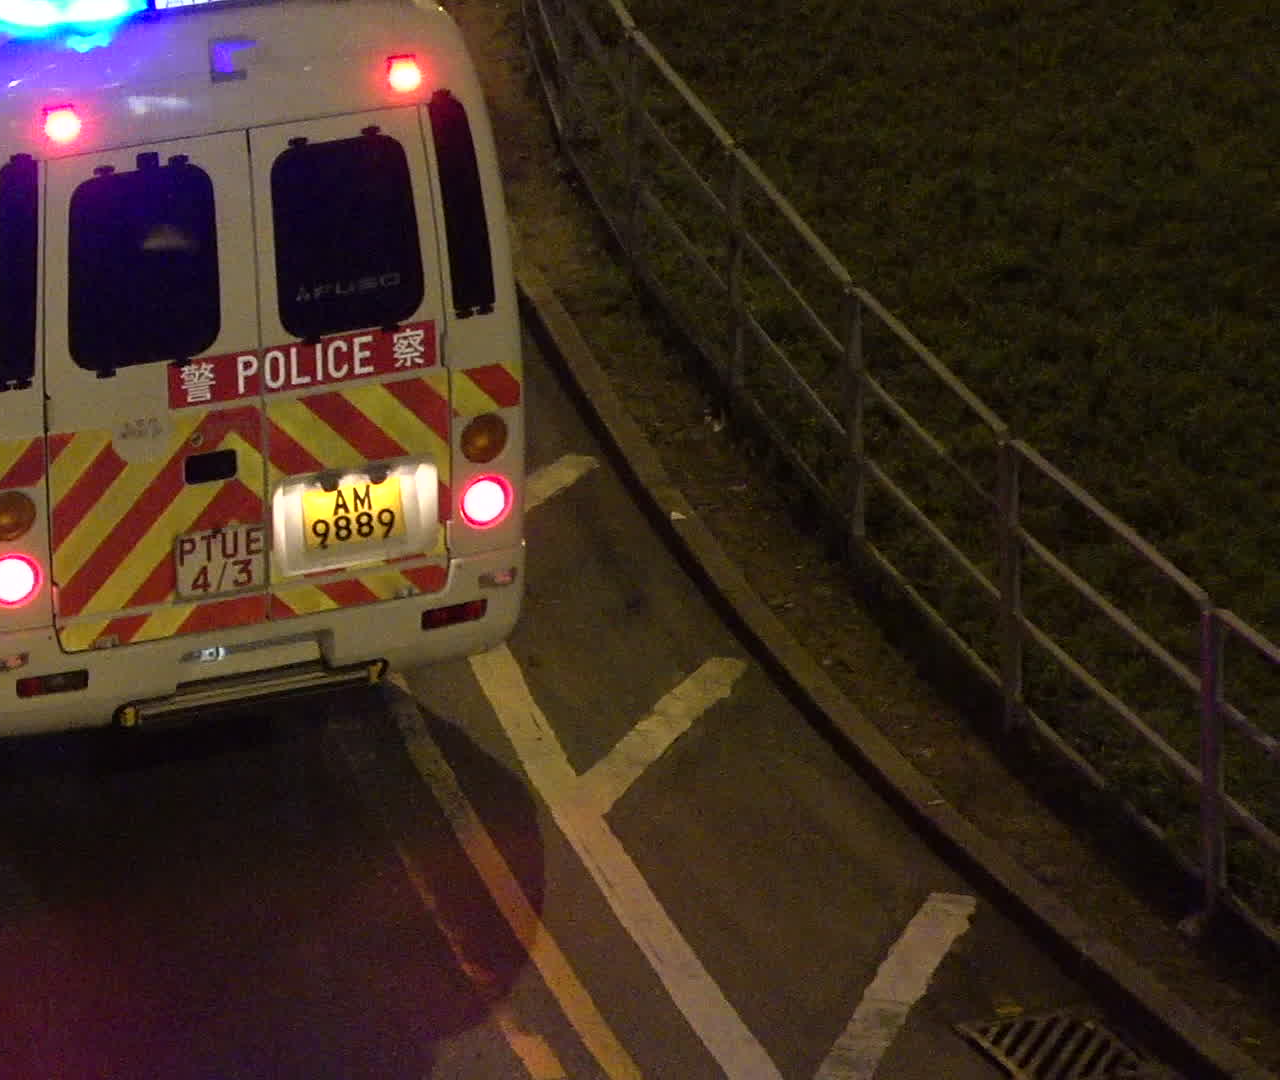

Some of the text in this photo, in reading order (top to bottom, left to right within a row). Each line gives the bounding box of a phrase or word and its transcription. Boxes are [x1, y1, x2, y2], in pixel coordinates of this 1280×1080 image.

[180, 327, 425, 404] 警 POLICE 察
[332, 484, 373, 517] AM
[179, 526, 264, 568] PTUE
[311, 508, 396, 550] 9889
[190, 558, 253, 594] 4/3
